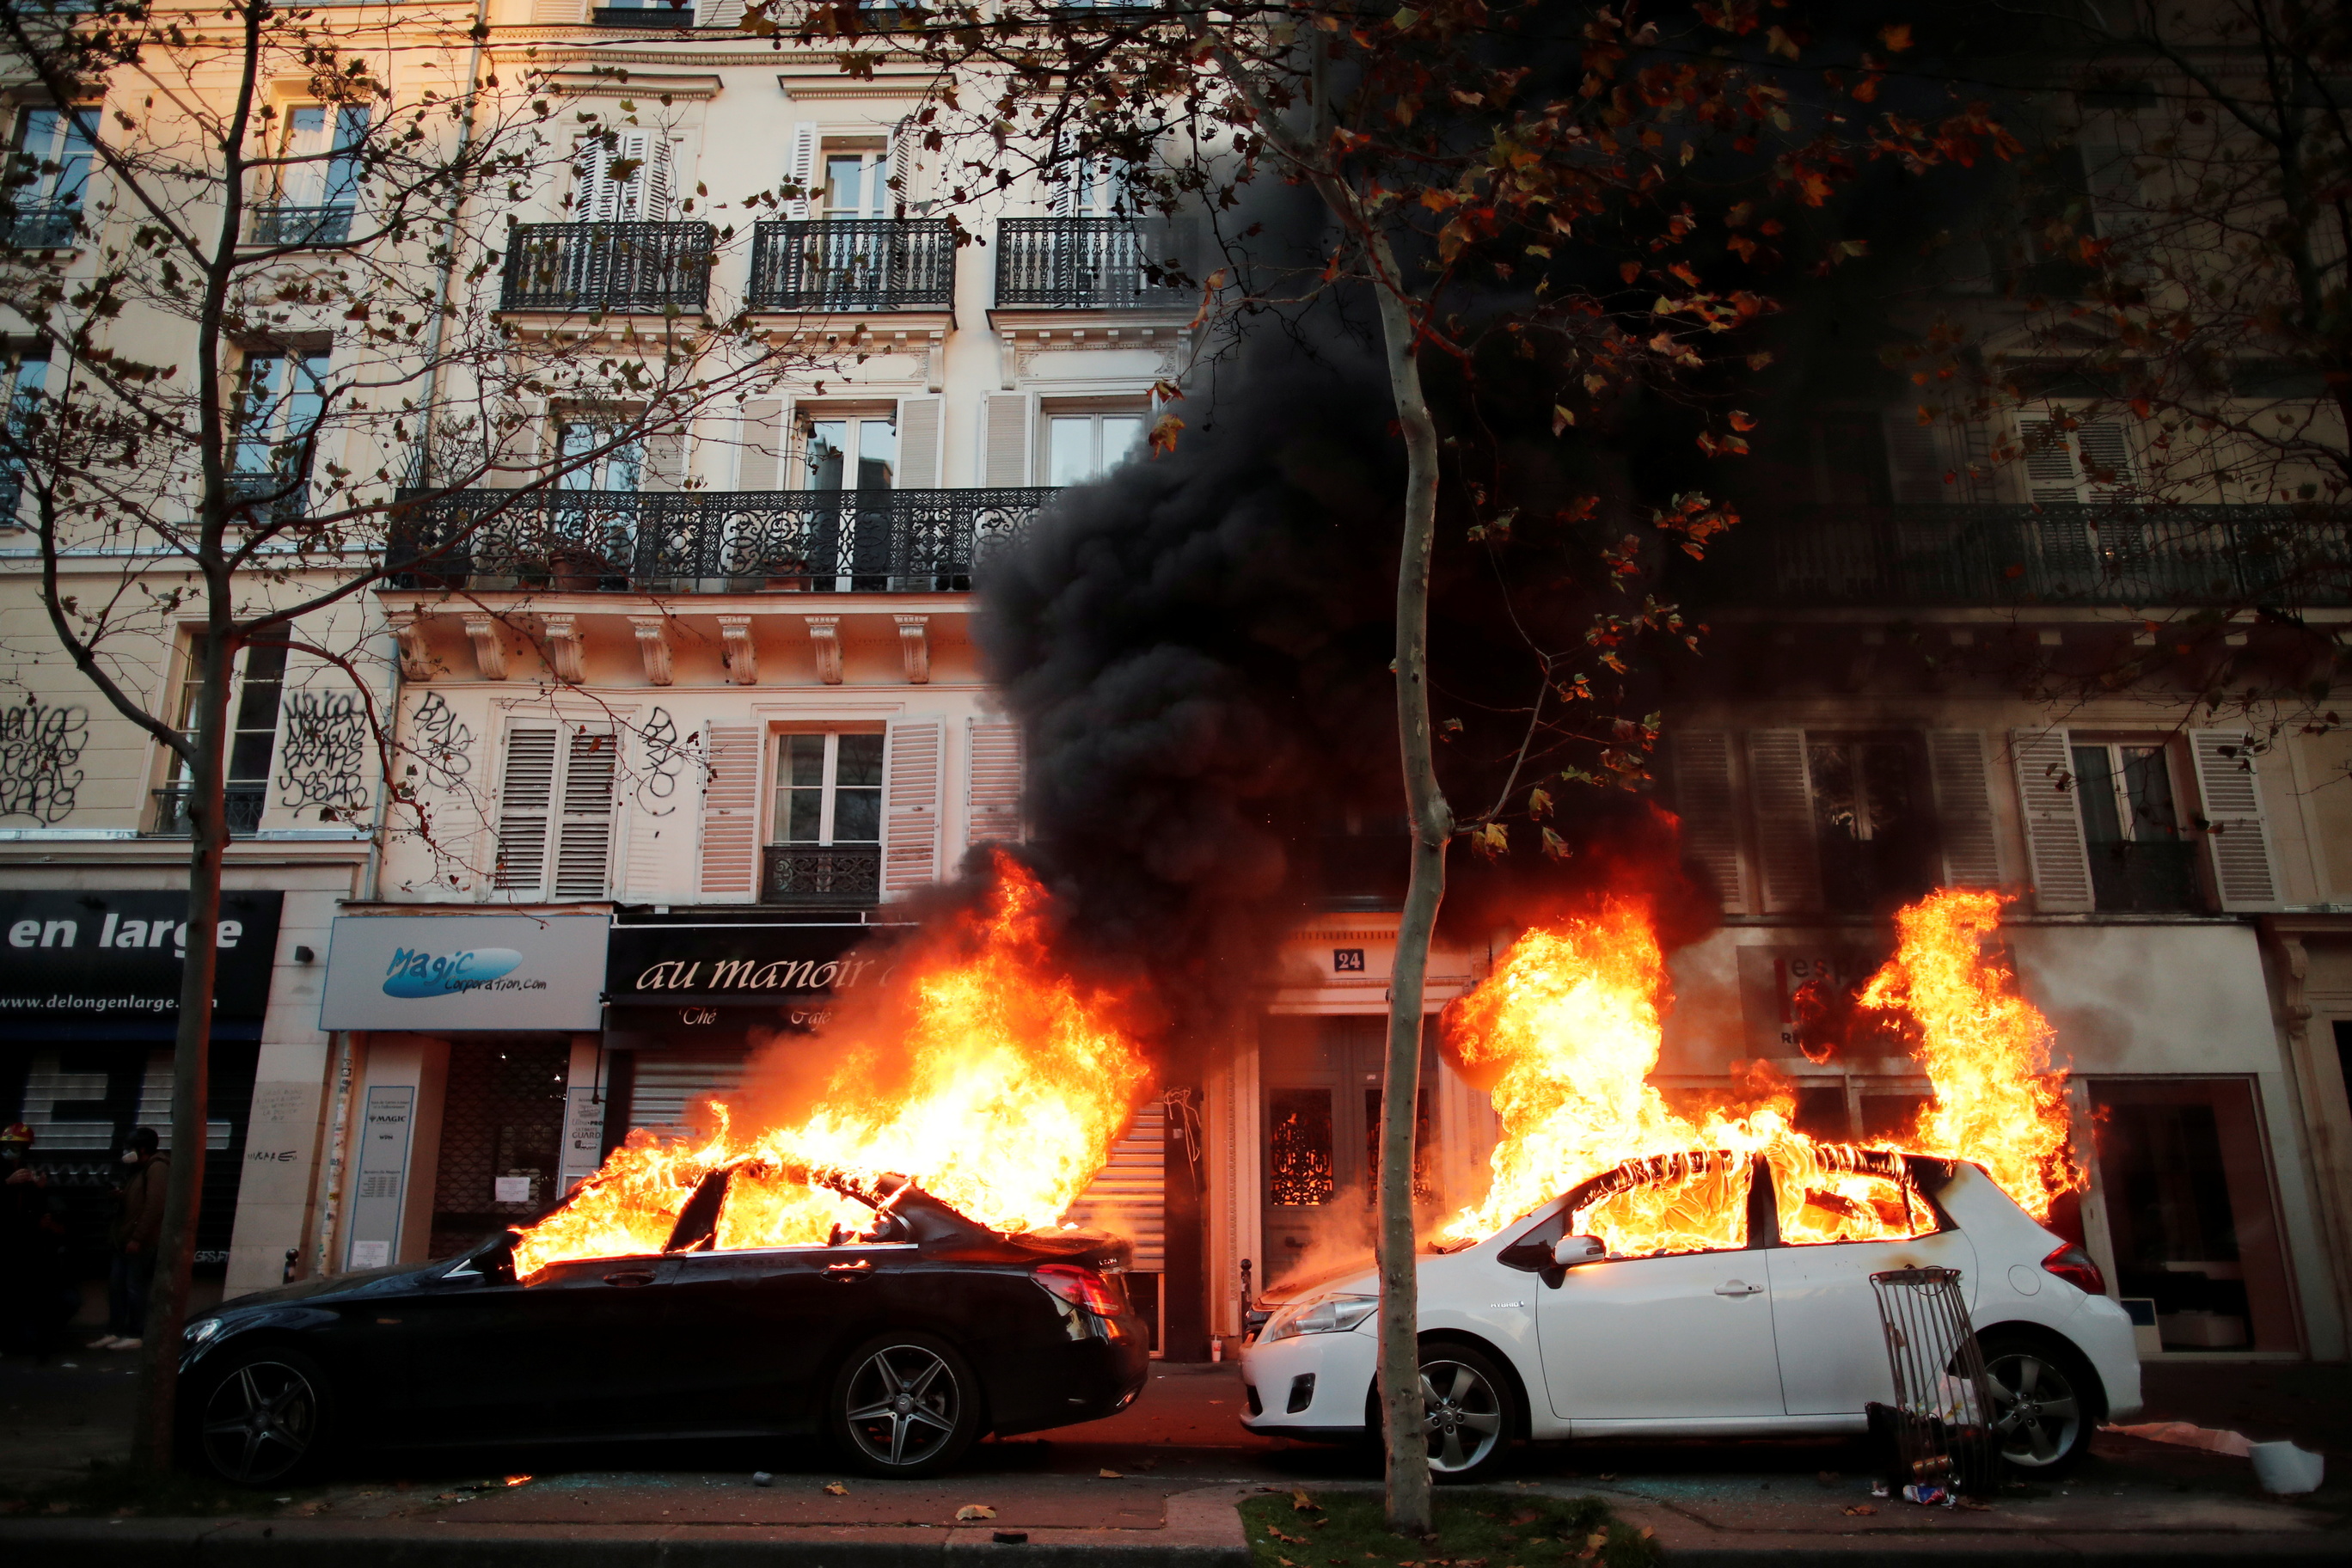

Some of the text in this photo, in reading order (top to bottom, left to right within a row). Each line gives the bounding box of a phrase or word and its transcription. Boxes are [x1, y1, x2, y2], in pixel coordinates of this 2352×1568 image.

[8, 919, 78, 948] en
[387, 946, 475, 986] Magic
[635, 959, 701, 990] au
[707, 950, 875, 990] manoir
[1338, 952, 1361, 969] 24
[0, 994, 218, 1013] www.delongenlarge.
